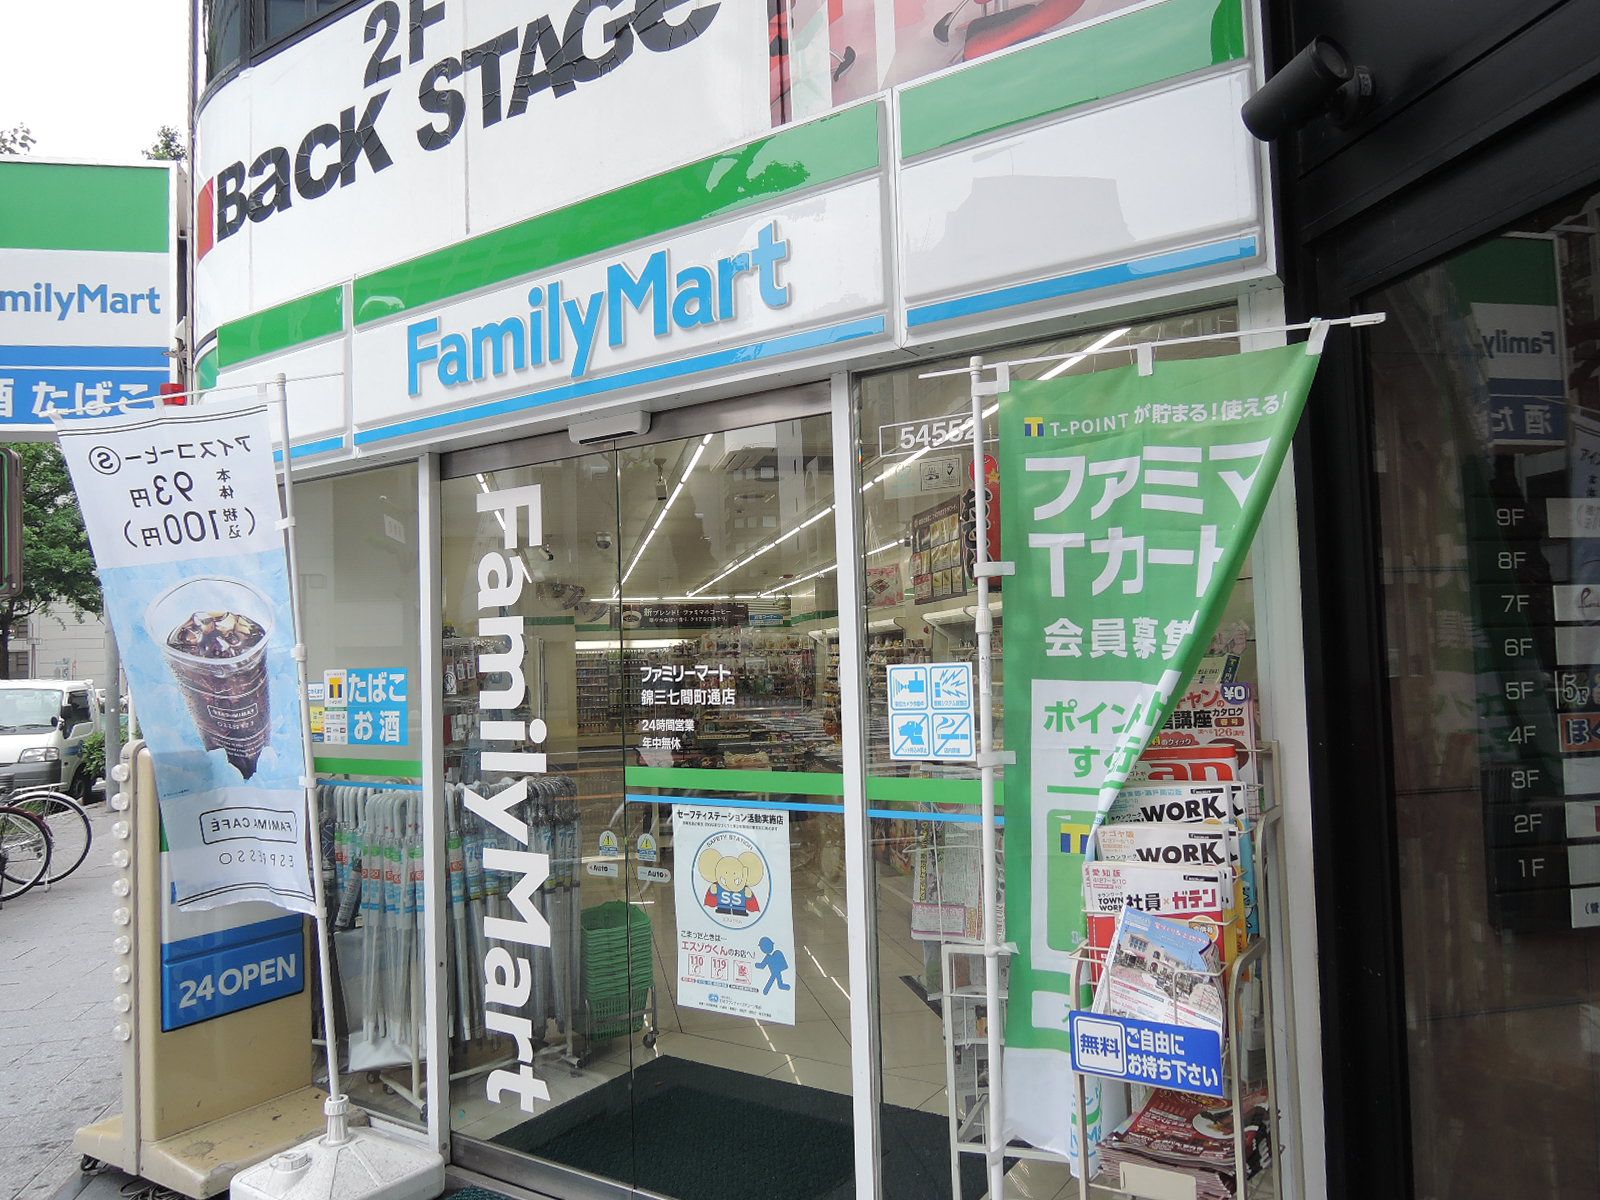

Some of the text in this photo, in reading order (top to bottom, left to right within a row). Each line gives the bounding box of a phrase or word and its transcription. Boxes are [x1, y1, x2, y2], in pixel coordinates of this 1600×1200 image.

[364, 0, 446, 89] 2F
[406, 221, 791, 398] FamilyMart
[32, 381, 157, 418] たばこ
[1050, 413, 1130, 437] T-POINT
[1496, 508, 1525, 527] 9F
[1498, 551, 1527, 570] 8F
[1501, 595, 1530, 613] 7F
[1504, 638, 1534, 657] 6F
[640, 664, 732, 683] ファミリーマート
[348, 671, 407, 703] たばこ
[1505, 682, 1534, 700] 5F
[641, 688, 736, 707] 錦三七間町通店
[1212, 707, 1244, 718] カタログ
[354, 710, 401, 743] お酒
[642, 719, 696, 733] 24時間営業
[1508, 725, 1537, 744] 4F
[642, 737, 682, 750] 年中無休
[1511, 770, 1540, 789] 3F
[464, 484, 551, 1113] FamilyMart
[677, 810, 785, 826] セーフティステーション活動実施店
[1140, 795, 1227, 823] WORK
[1514, 814, 1543, 833] 2F
[1136, 841, 1226, 865] WORK
[1518, 859, 1545, 878] 1F
[721, 890, 742, 906] SS
[1098, 897, 1124, 905] TOWN
[179, 953, 296, 1010] 24 OPEN
[1079, 1032, 1121, 1060] 無料
[1126, 1027, 1185, 1056] ご自由に
[1127, 1054, 1219, 1088] お持ち下さい
